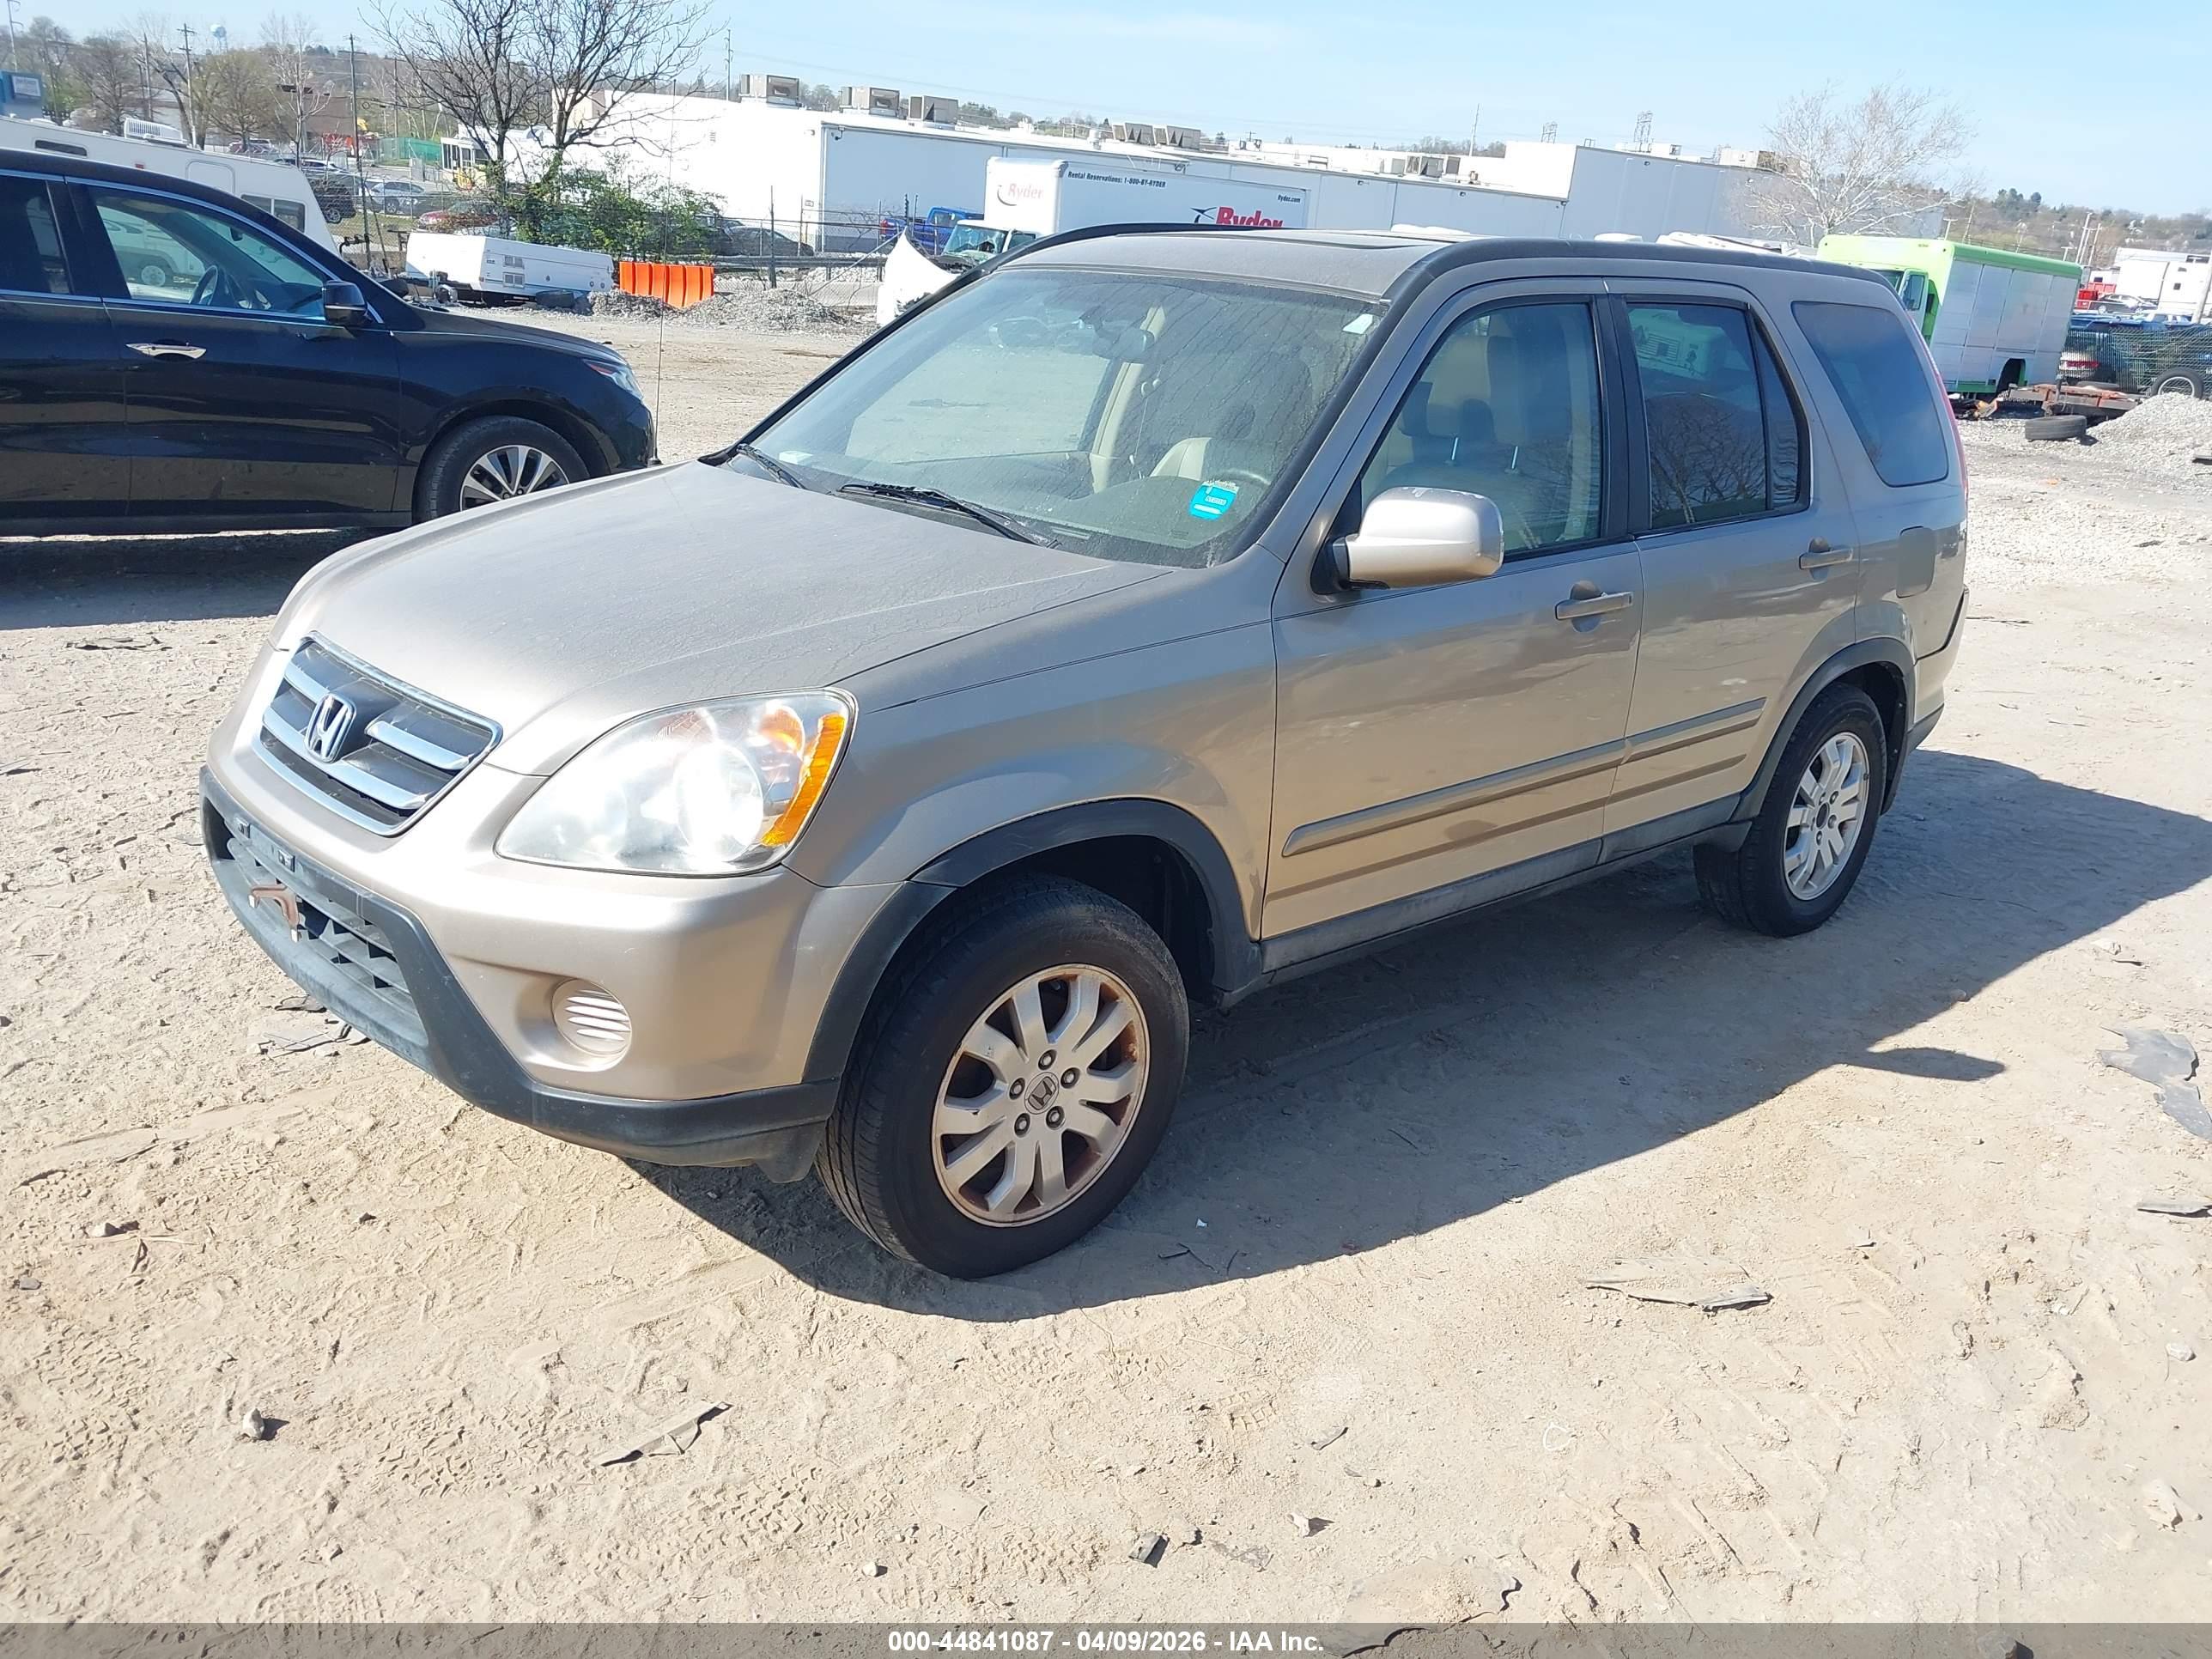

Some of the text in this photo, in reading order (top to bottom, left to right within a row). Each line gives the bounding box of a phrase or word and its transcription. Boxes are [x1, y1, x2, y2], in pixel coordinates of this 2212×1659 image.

[1086, 173, 1123, 183] Reservations:
[1008, 181, 1044, 199] Ryder
[1277, 194, 1301, 203] Ryder.com
